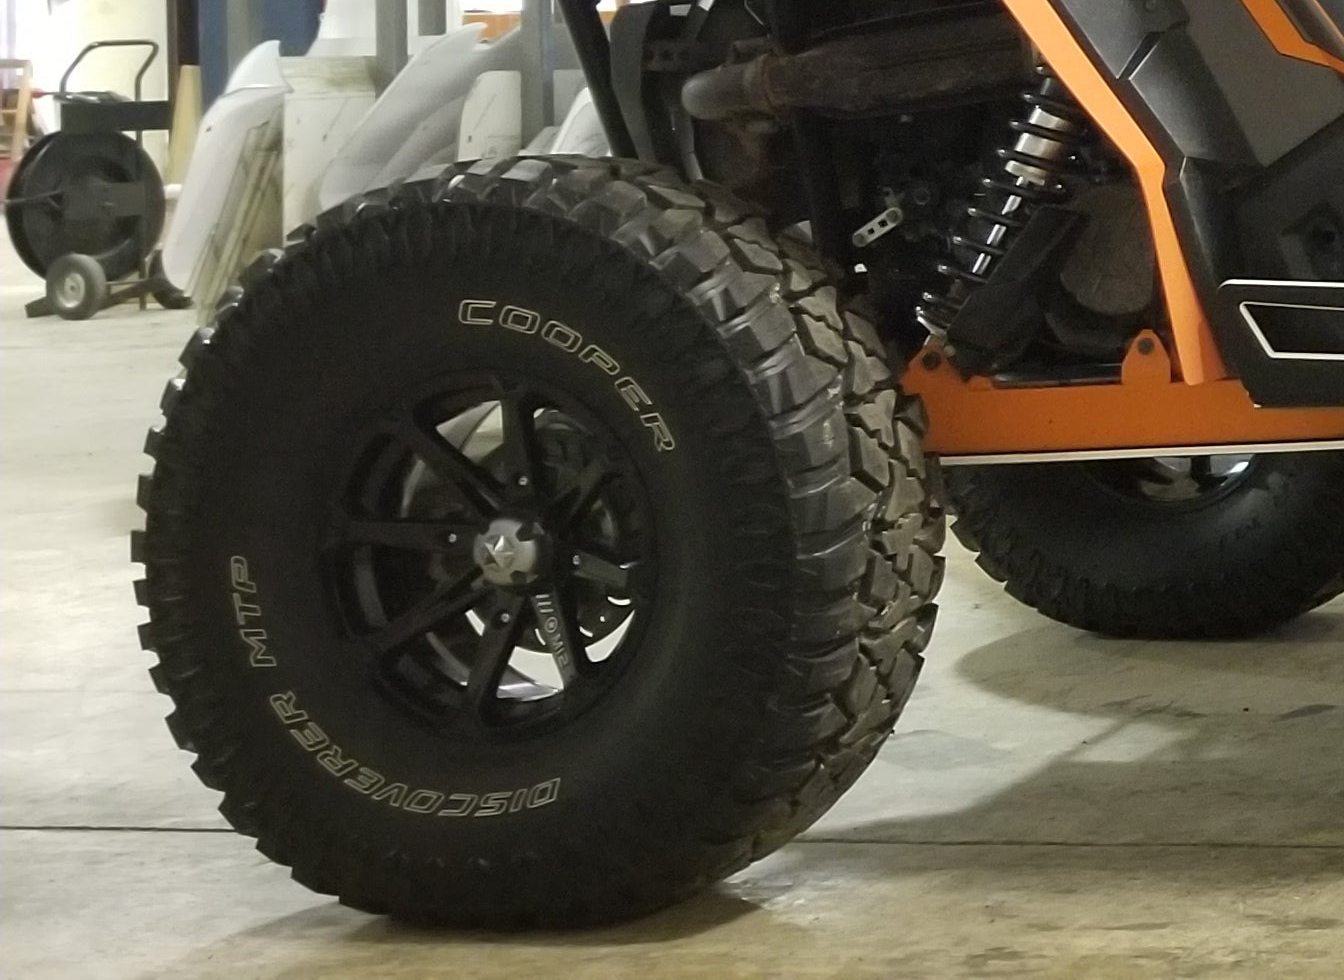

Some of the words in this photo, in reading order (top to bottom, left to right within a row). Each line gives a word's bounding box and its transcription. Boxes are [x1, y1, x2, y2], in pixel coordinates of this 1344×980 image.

[458, 298, 676, 453] COOPER
[230, 555, 277, 668] MTP
[269, 690, 561, 818] DISCOVERER
